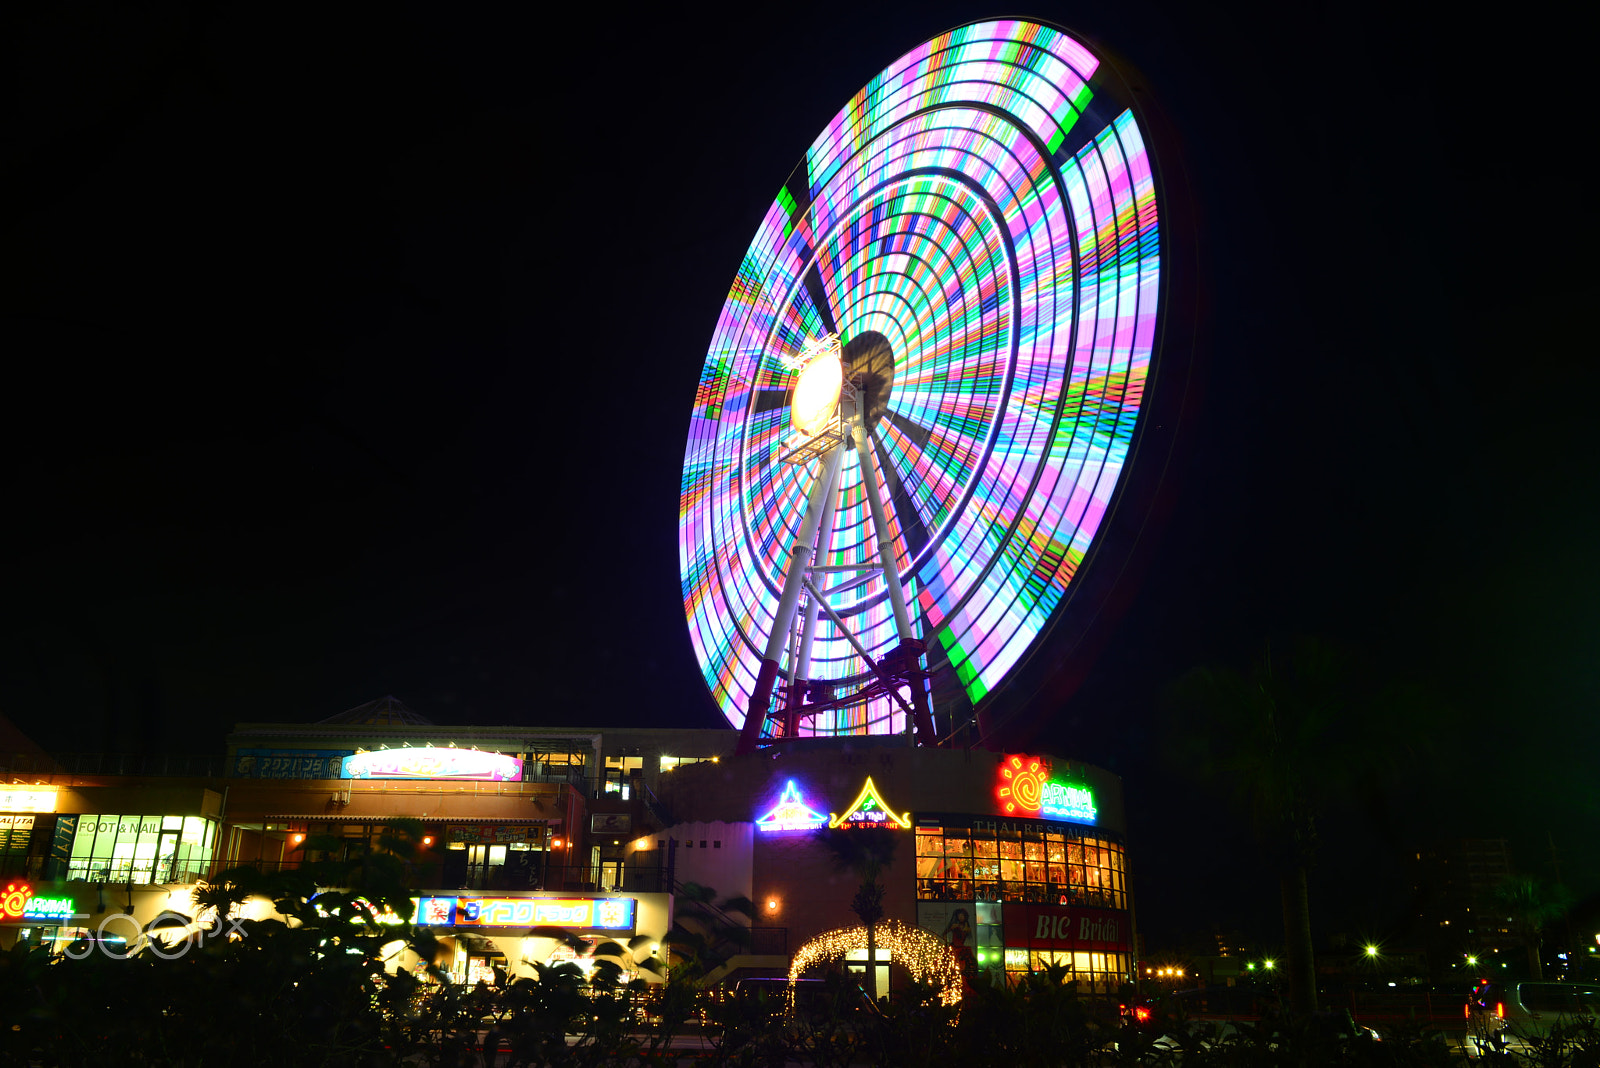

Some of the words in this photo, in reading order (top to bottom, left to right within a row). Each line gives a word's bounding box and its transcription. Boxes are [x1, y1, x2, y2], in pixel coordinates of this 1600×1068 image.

[78, 821, 116, 833] FOOT
[118, 823, 127, 833] &
[129, 823, 160, 834] NAIL
[973, 820, 1017, 835] THAI
[1024, 823, 1109, 844] RESTAURANT
[1034, 914, 1071, 940] BIC
[1079, 916, 1119, 943] Bridal
